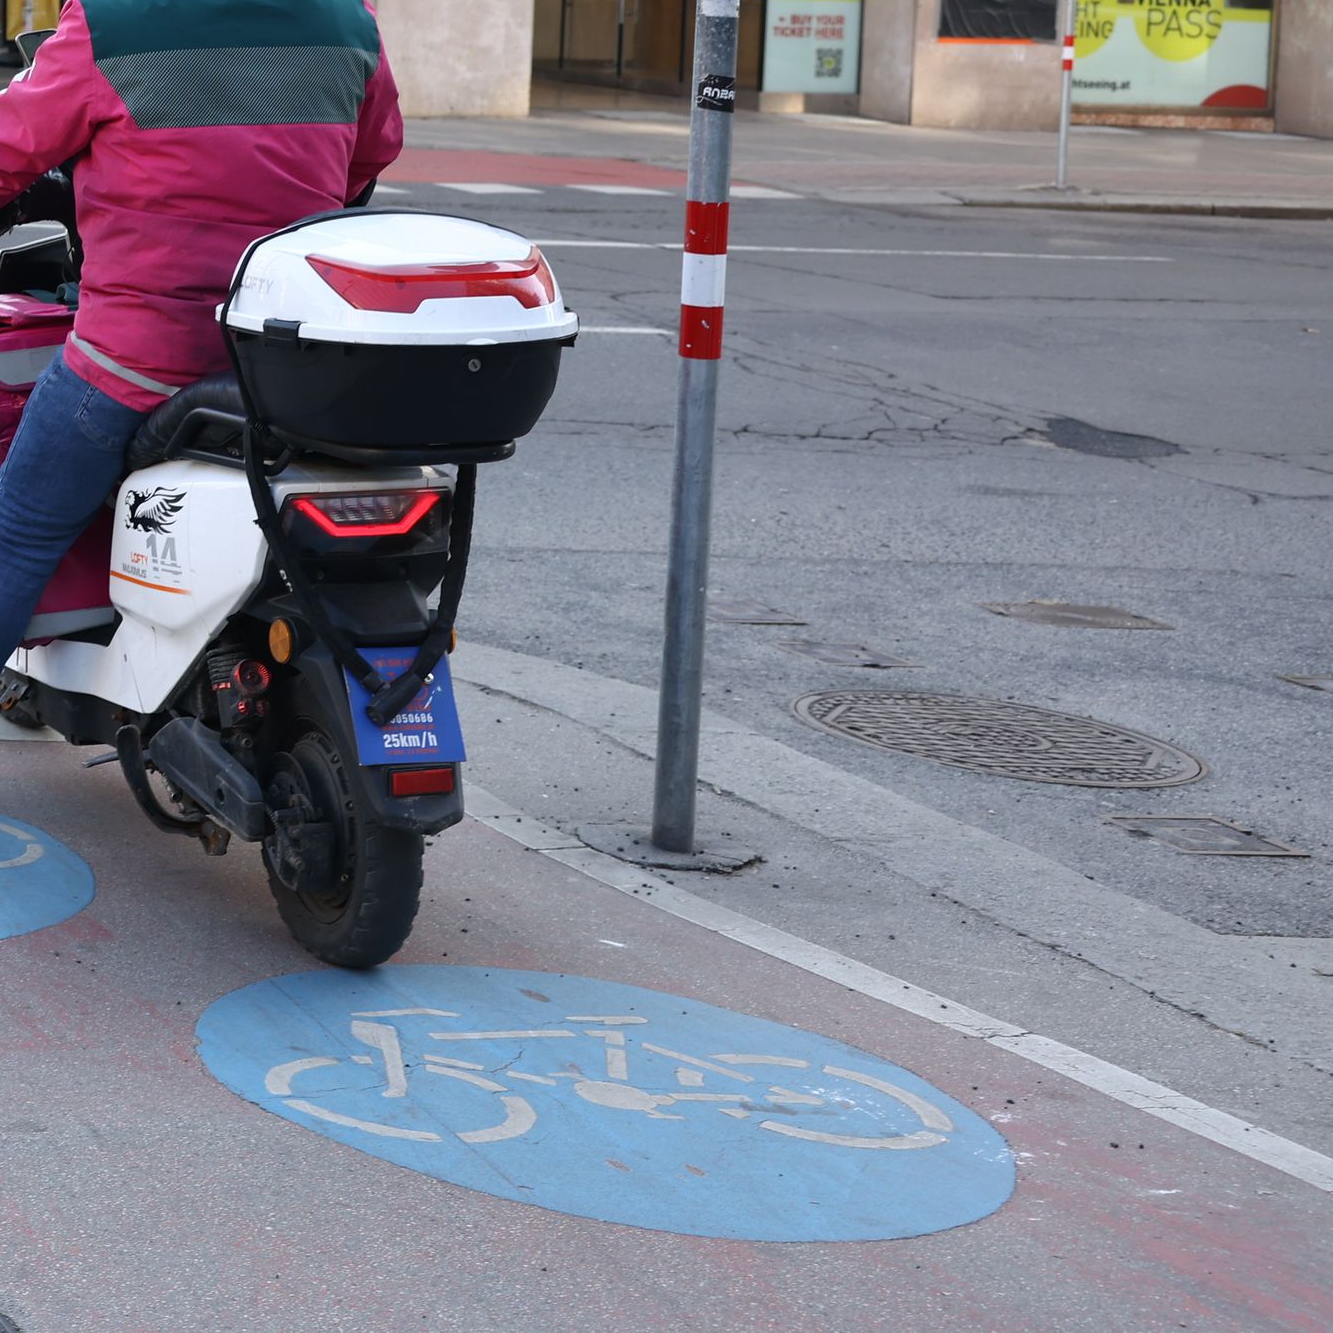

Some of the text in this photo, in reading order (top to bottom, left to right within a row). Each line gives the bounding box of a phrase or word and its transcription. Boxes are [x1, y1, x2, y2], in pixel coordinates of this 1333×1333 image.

[1076, 0, 1100, 19] HT
[1145, 8, 1223, 40] PASS
[1072, 79, 1131, 92] htseeing.at
[383, 731, 438, 749] 25km/h
